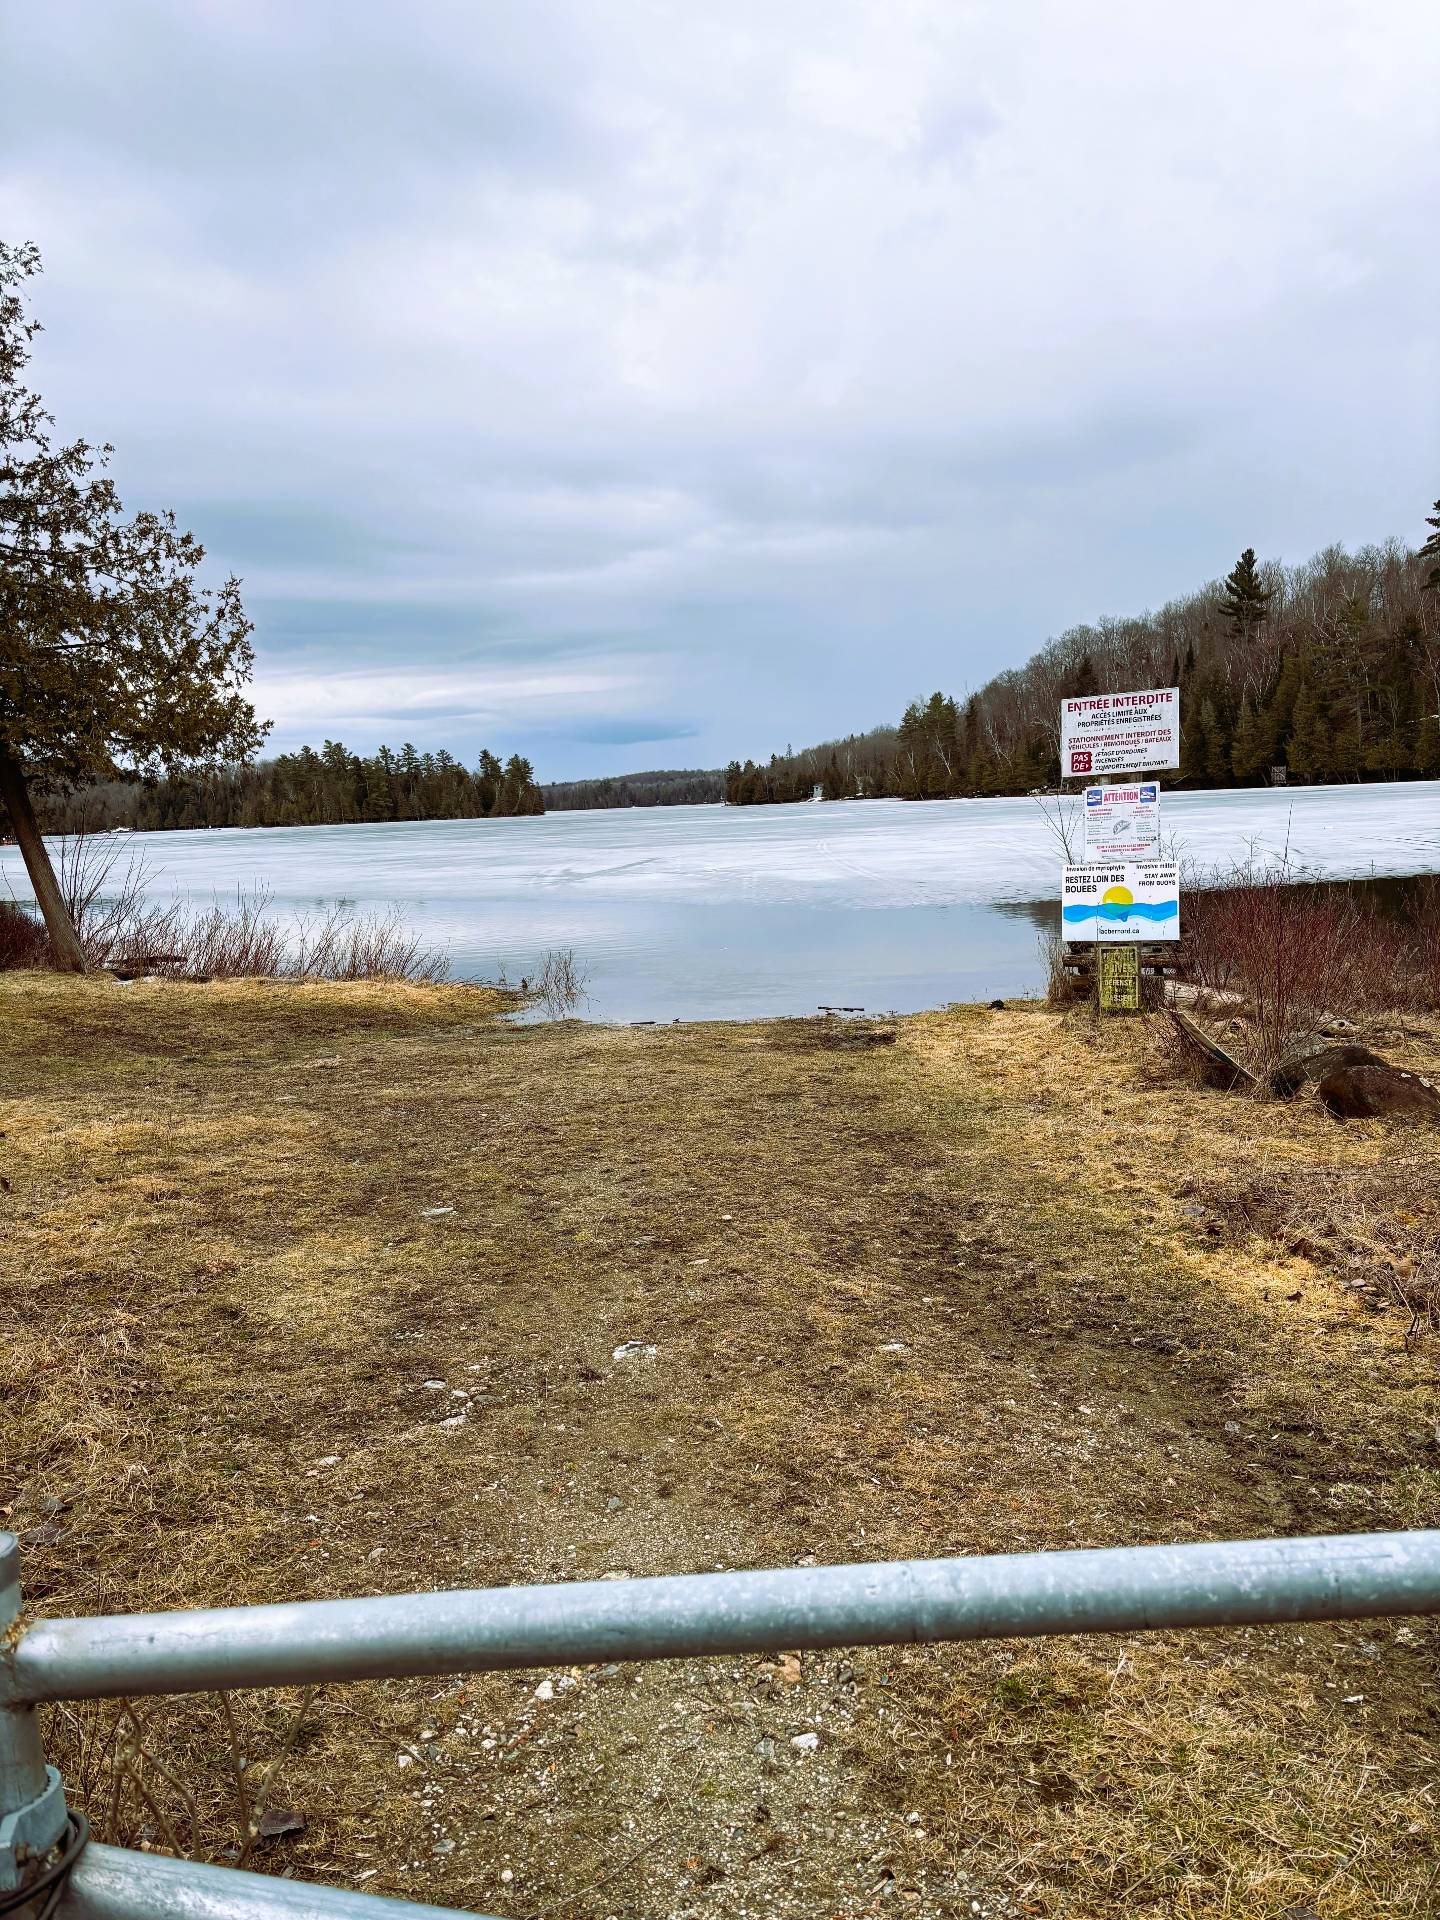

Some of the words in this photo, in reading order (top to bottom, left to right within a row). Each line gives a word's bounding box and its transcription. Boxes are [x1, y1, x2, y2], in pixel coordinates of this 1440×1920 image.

[1068, 698, 1109, 712] ENTRÉE
[1112, 693, 1172, 707] INTERDITE
[1116, 714, 1162, 724] ENREGISTRÉES
[1068, 734, 1124, 744] STATIONNEMENT
[1126, 731, 1156, 739] INTERDIT
[1073, 754, 1088, 762] PAS
[1104, 792, 1138, 802] ATTENTION
[1066, 876, 1091, 884] RESTEZ
